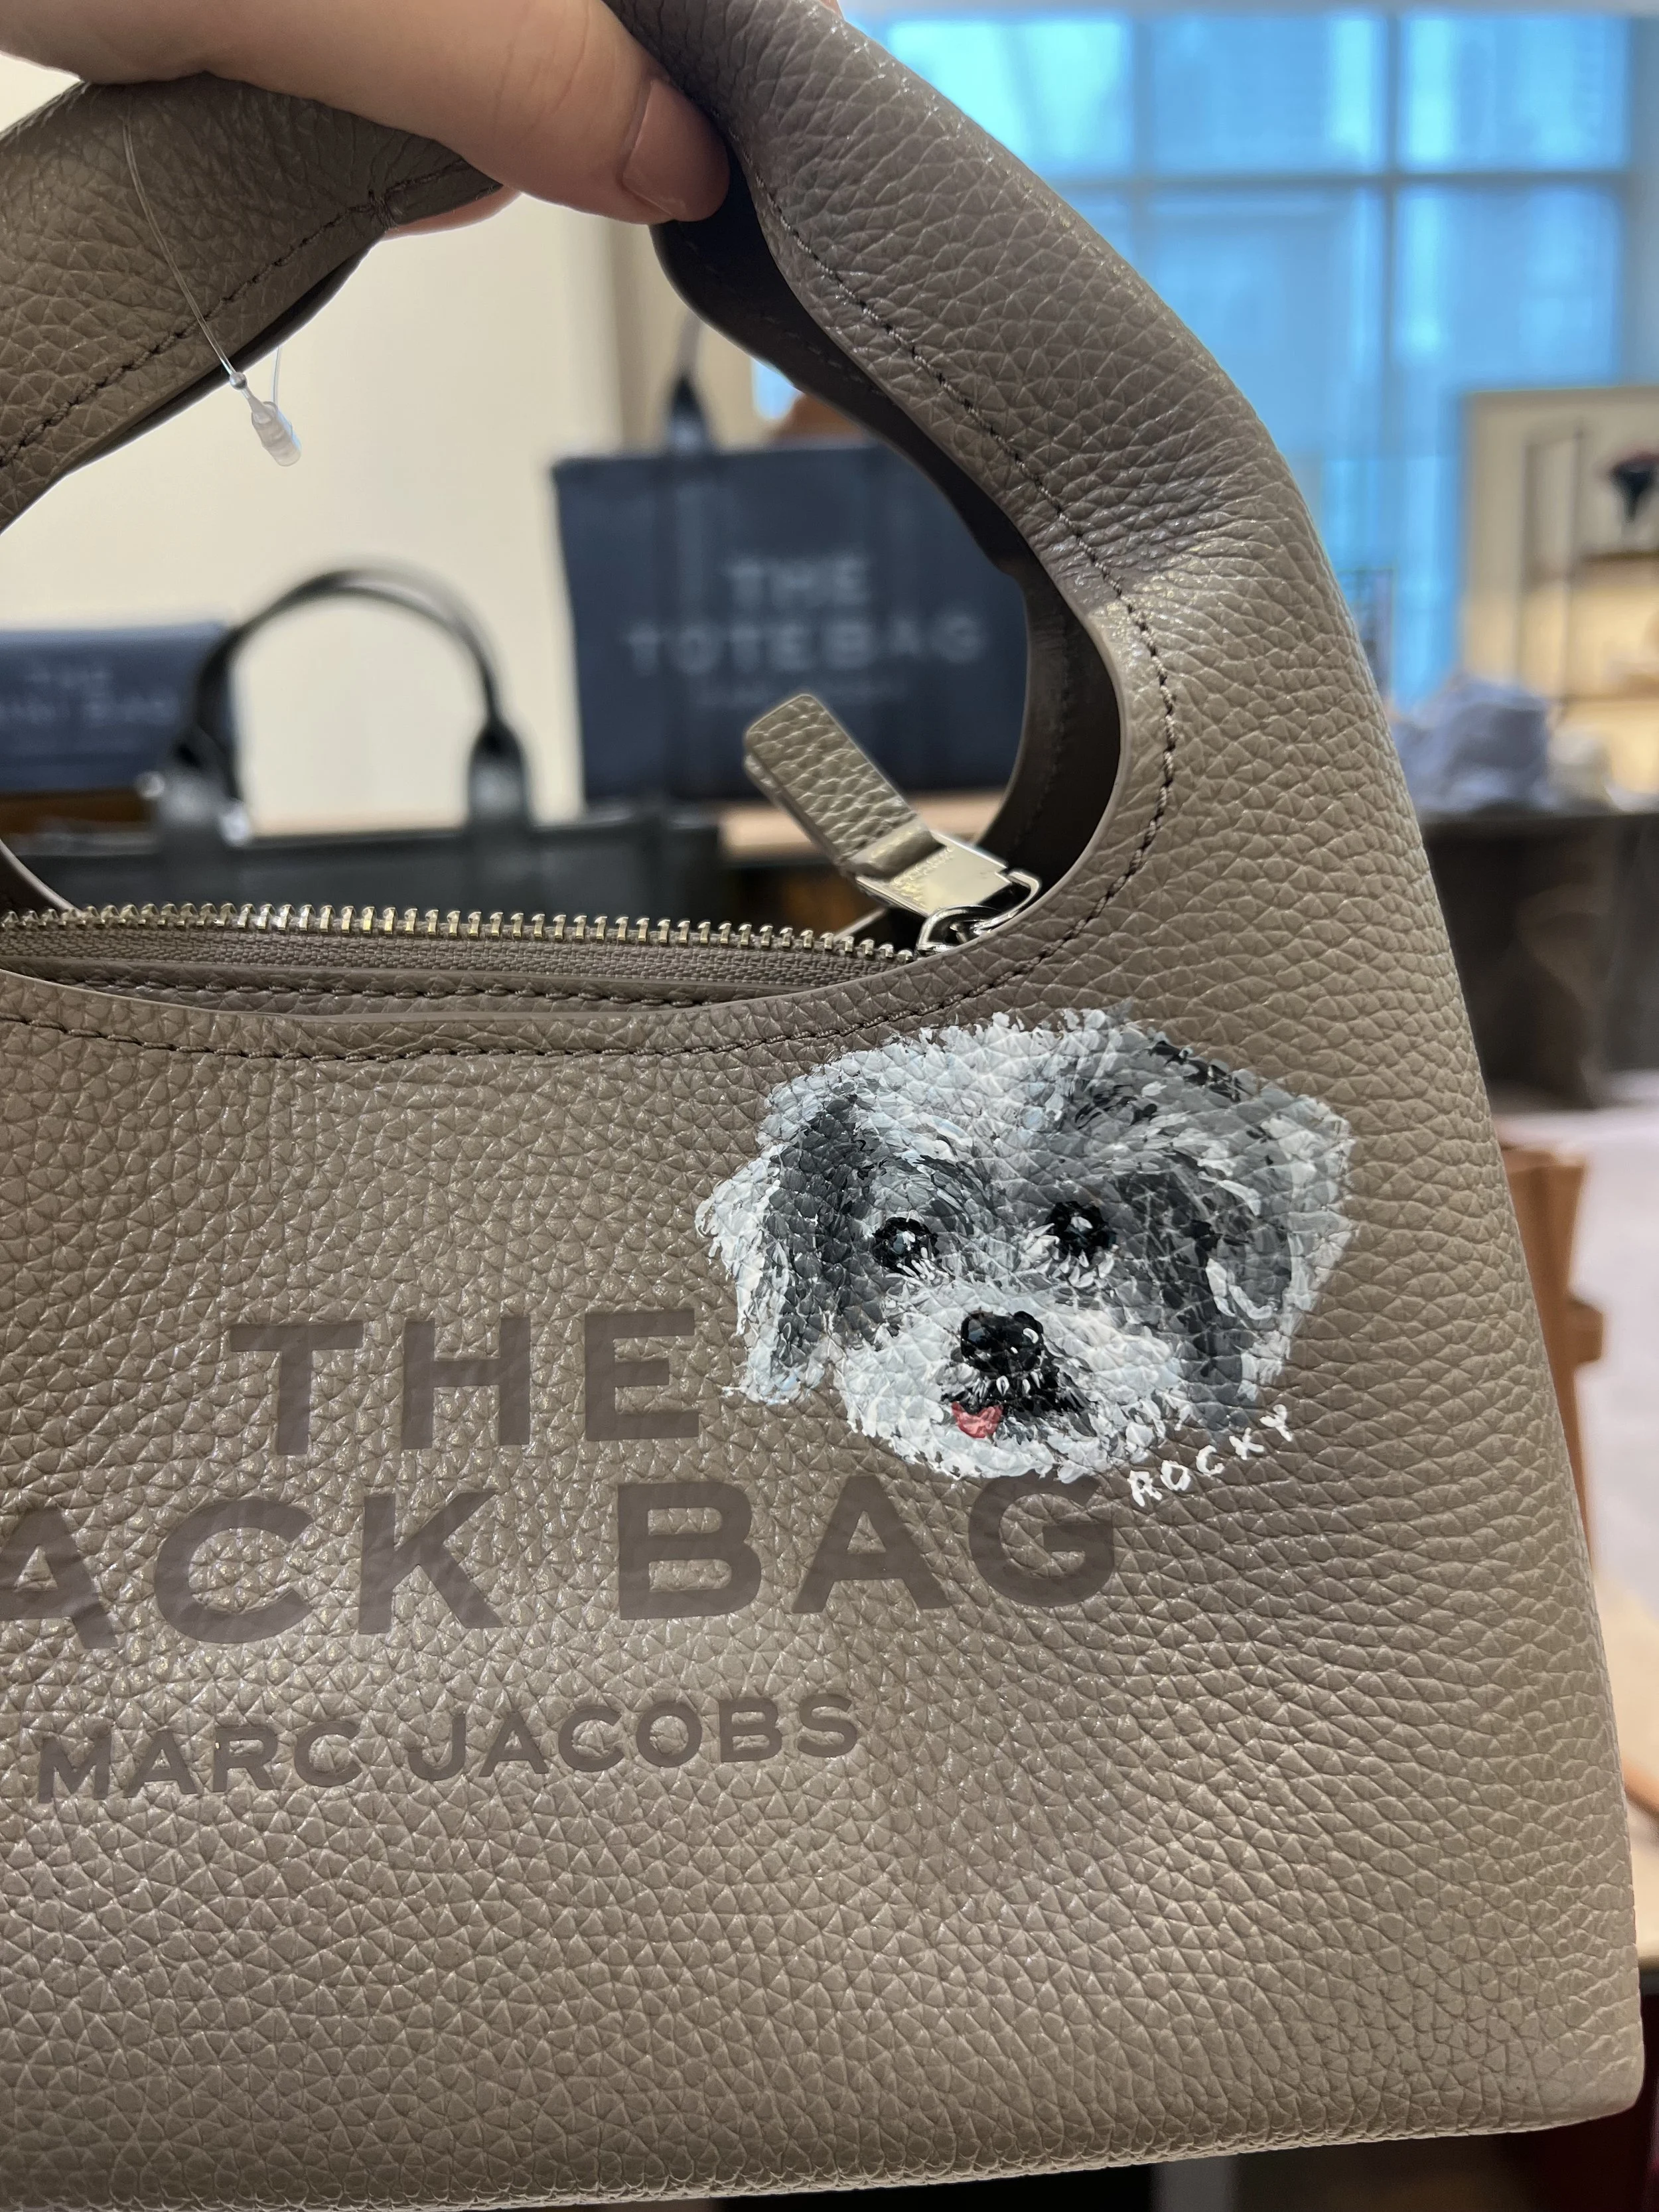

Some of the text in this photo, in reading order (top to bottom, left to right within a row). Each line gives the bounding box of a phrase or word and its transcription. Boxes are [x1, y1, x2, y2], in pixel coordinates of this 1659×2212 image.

[727, 554, 868, 607] THE
[625, 611, 984, 675] TOTE BAG
[230, 1309, 699, 1455] THE
[1127, 1404, 1293, 1507] ROCKY
[618, 1469, 1116, 1620] BAG
[38, 1694, 857, 1803] MARC JACOBS
